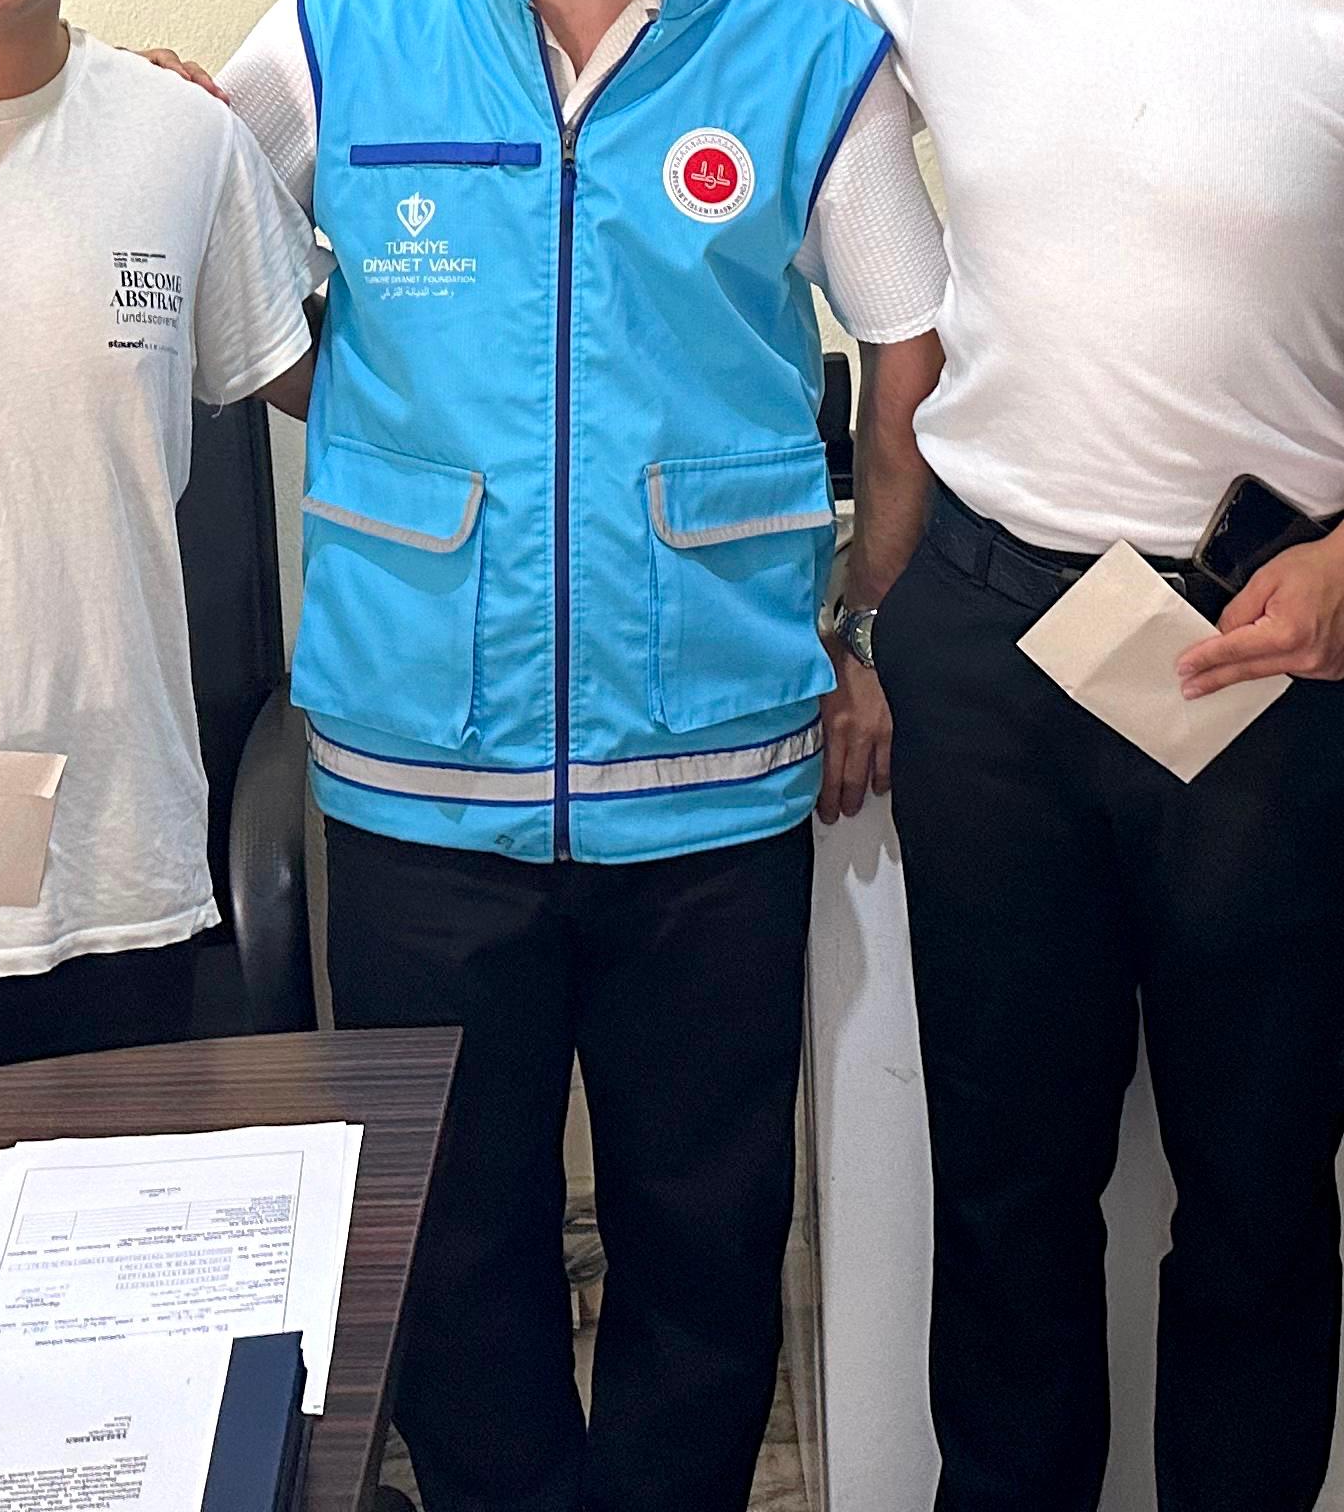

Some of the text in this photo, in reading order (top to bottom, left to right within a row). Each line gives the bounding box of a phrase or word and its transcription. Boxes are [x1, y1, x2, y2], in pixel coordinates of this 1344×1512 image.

[384, 238, 449, 255] TÜRKİYE
[363, 257, 477, 273] DİYANET VAKFI
[121, 270, 182, 294] BECOME
[109, 289, 184, 314] ABSTRACT
